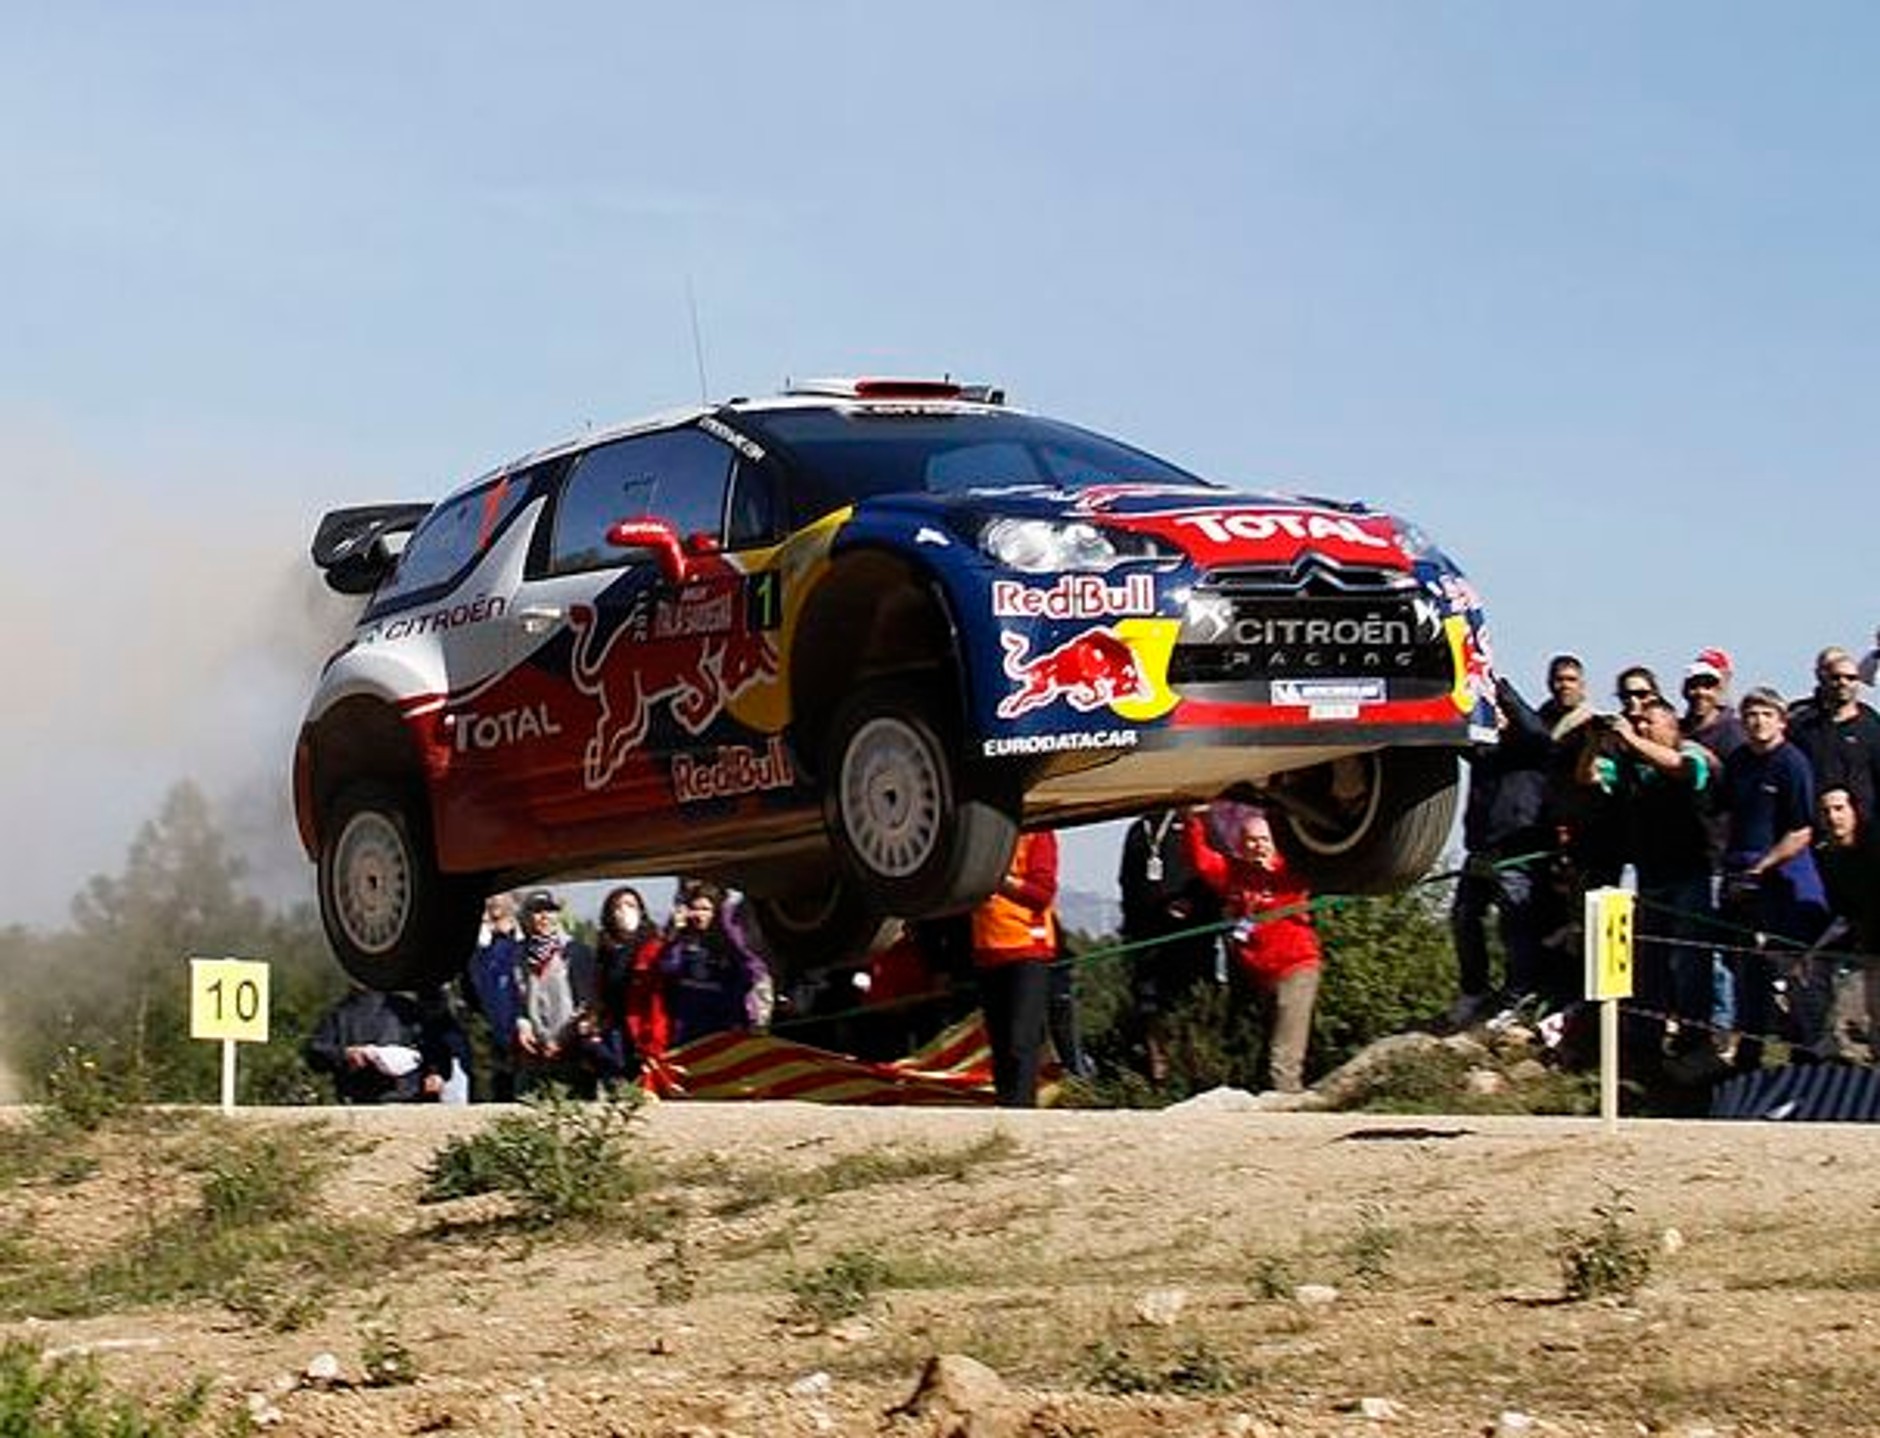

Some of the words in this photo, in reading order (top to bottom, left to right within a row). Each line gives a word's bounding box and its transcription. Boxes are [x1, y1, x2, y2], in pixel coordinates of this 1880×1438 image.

[1175, 514, 1388, 547] TOTAL
[757, 573, 773, 626] 1
[993, 575, 1074, 619] Red
[1074, 574, 1154, 618] Bull
[1231, 651, 1413, 667] RACING
[456, 701, 561, 753] TOTAL
[983, 730, 1138, 756] EURODATACAR
[671, 745, 729, 803] Red
[728, 737, 794, 794] Bull
[207, 978, 259, 1022] 10
